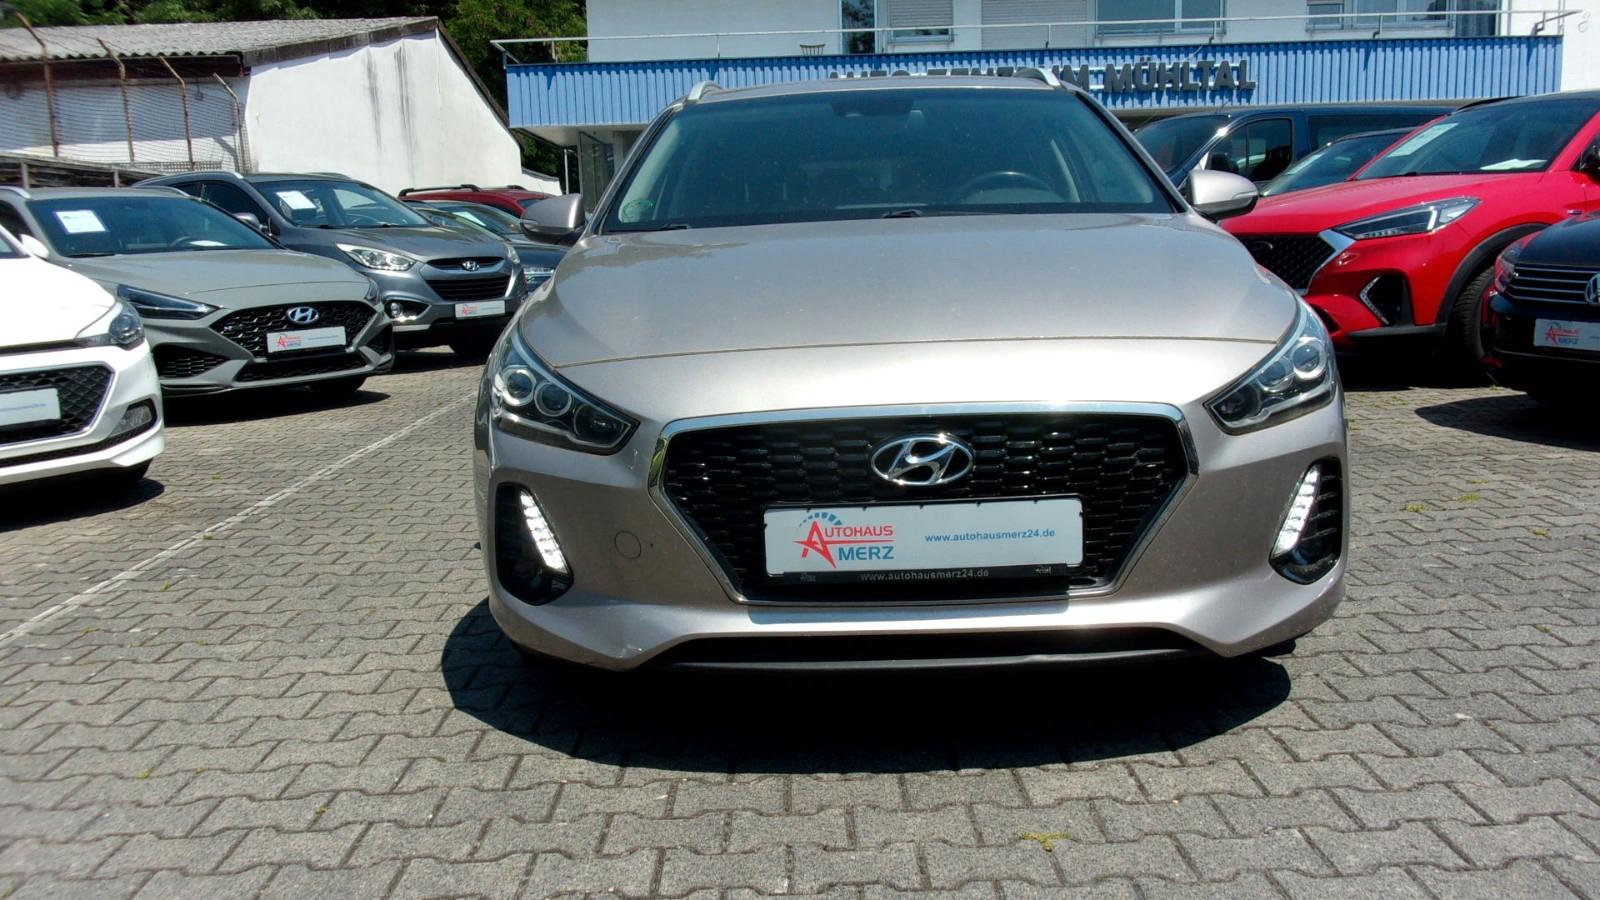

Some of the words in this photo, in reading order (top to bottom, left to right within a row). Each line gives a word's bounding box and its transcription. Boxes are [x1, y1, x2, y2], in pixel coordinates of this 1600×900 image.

[1102, 57, 1256, 92] MÜHLTAL
[797, 521, 894, 562] AUTOHAUS
[925, 529, 1056, 542] www.autohausmerz24.de
[838, 546, 895, 561] MERZ
[861, 568, 990, 581] www.autohausmerz24.de
